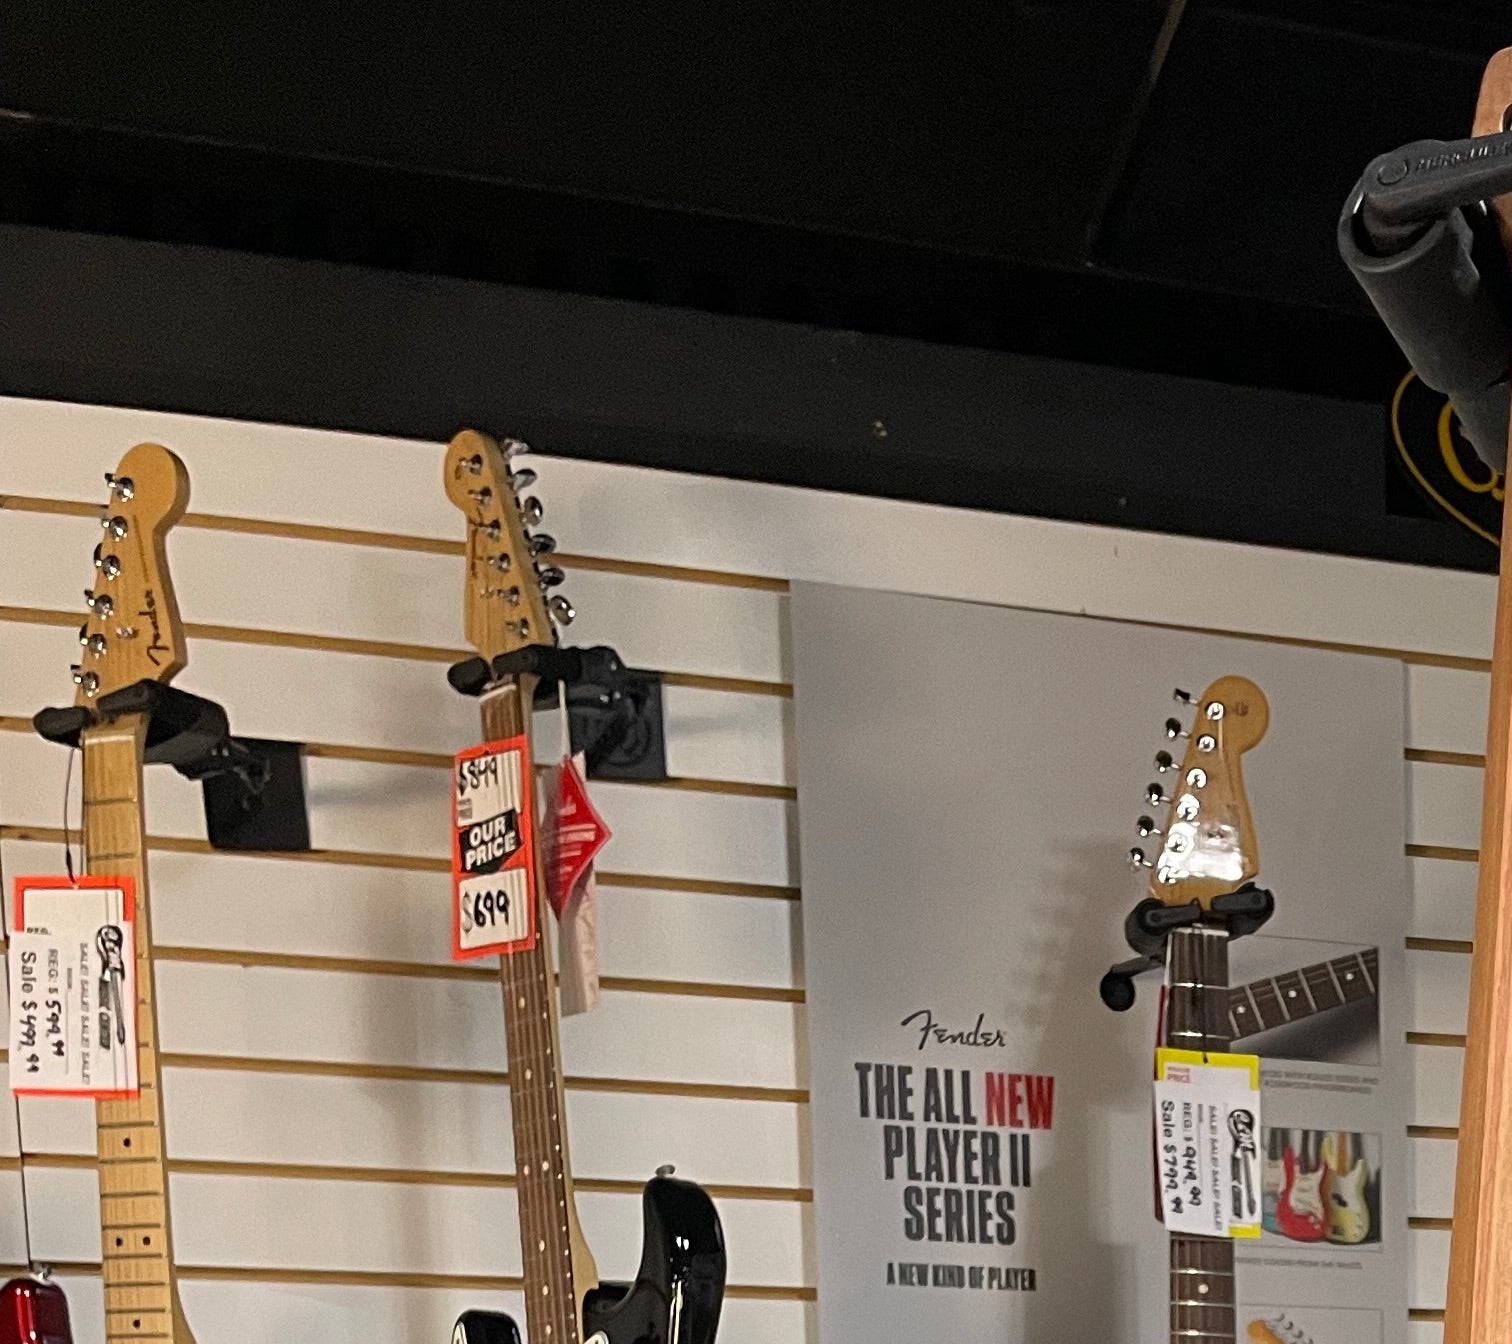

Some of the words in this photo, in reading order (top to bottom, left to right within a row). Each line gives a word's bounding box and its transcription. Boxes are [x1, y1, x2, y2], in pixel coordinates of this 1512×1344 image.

[464, 830, 516, 870] PRICE
[469, 816, 506, 846] OUR
[462, 889, 510, 933] $699
[21, 951, 37, 993] Sale
[901, 1009, 1007, 1050] Fender
[854, 1061, 914, 1121] THE
[923, 1066, 977, 1125] ALL
[984, 1071, 1055, 1130] NEW
[1161, 1100, 1175, 1139] Sale
[883, 1124, 1002, 1186] PLAYER
[1009, 1133, 1031, 1188] II
[903, 1185, 1016, 1246] SERIES
[886, 1262, 896, 1286] A
[898, 1263, 930, 1287] NEW
[932, 1264, 966, 1289] KIND
[968, 1266, 985, 1290] OF
[987, 1267, 1036, 1292] PLAYER
